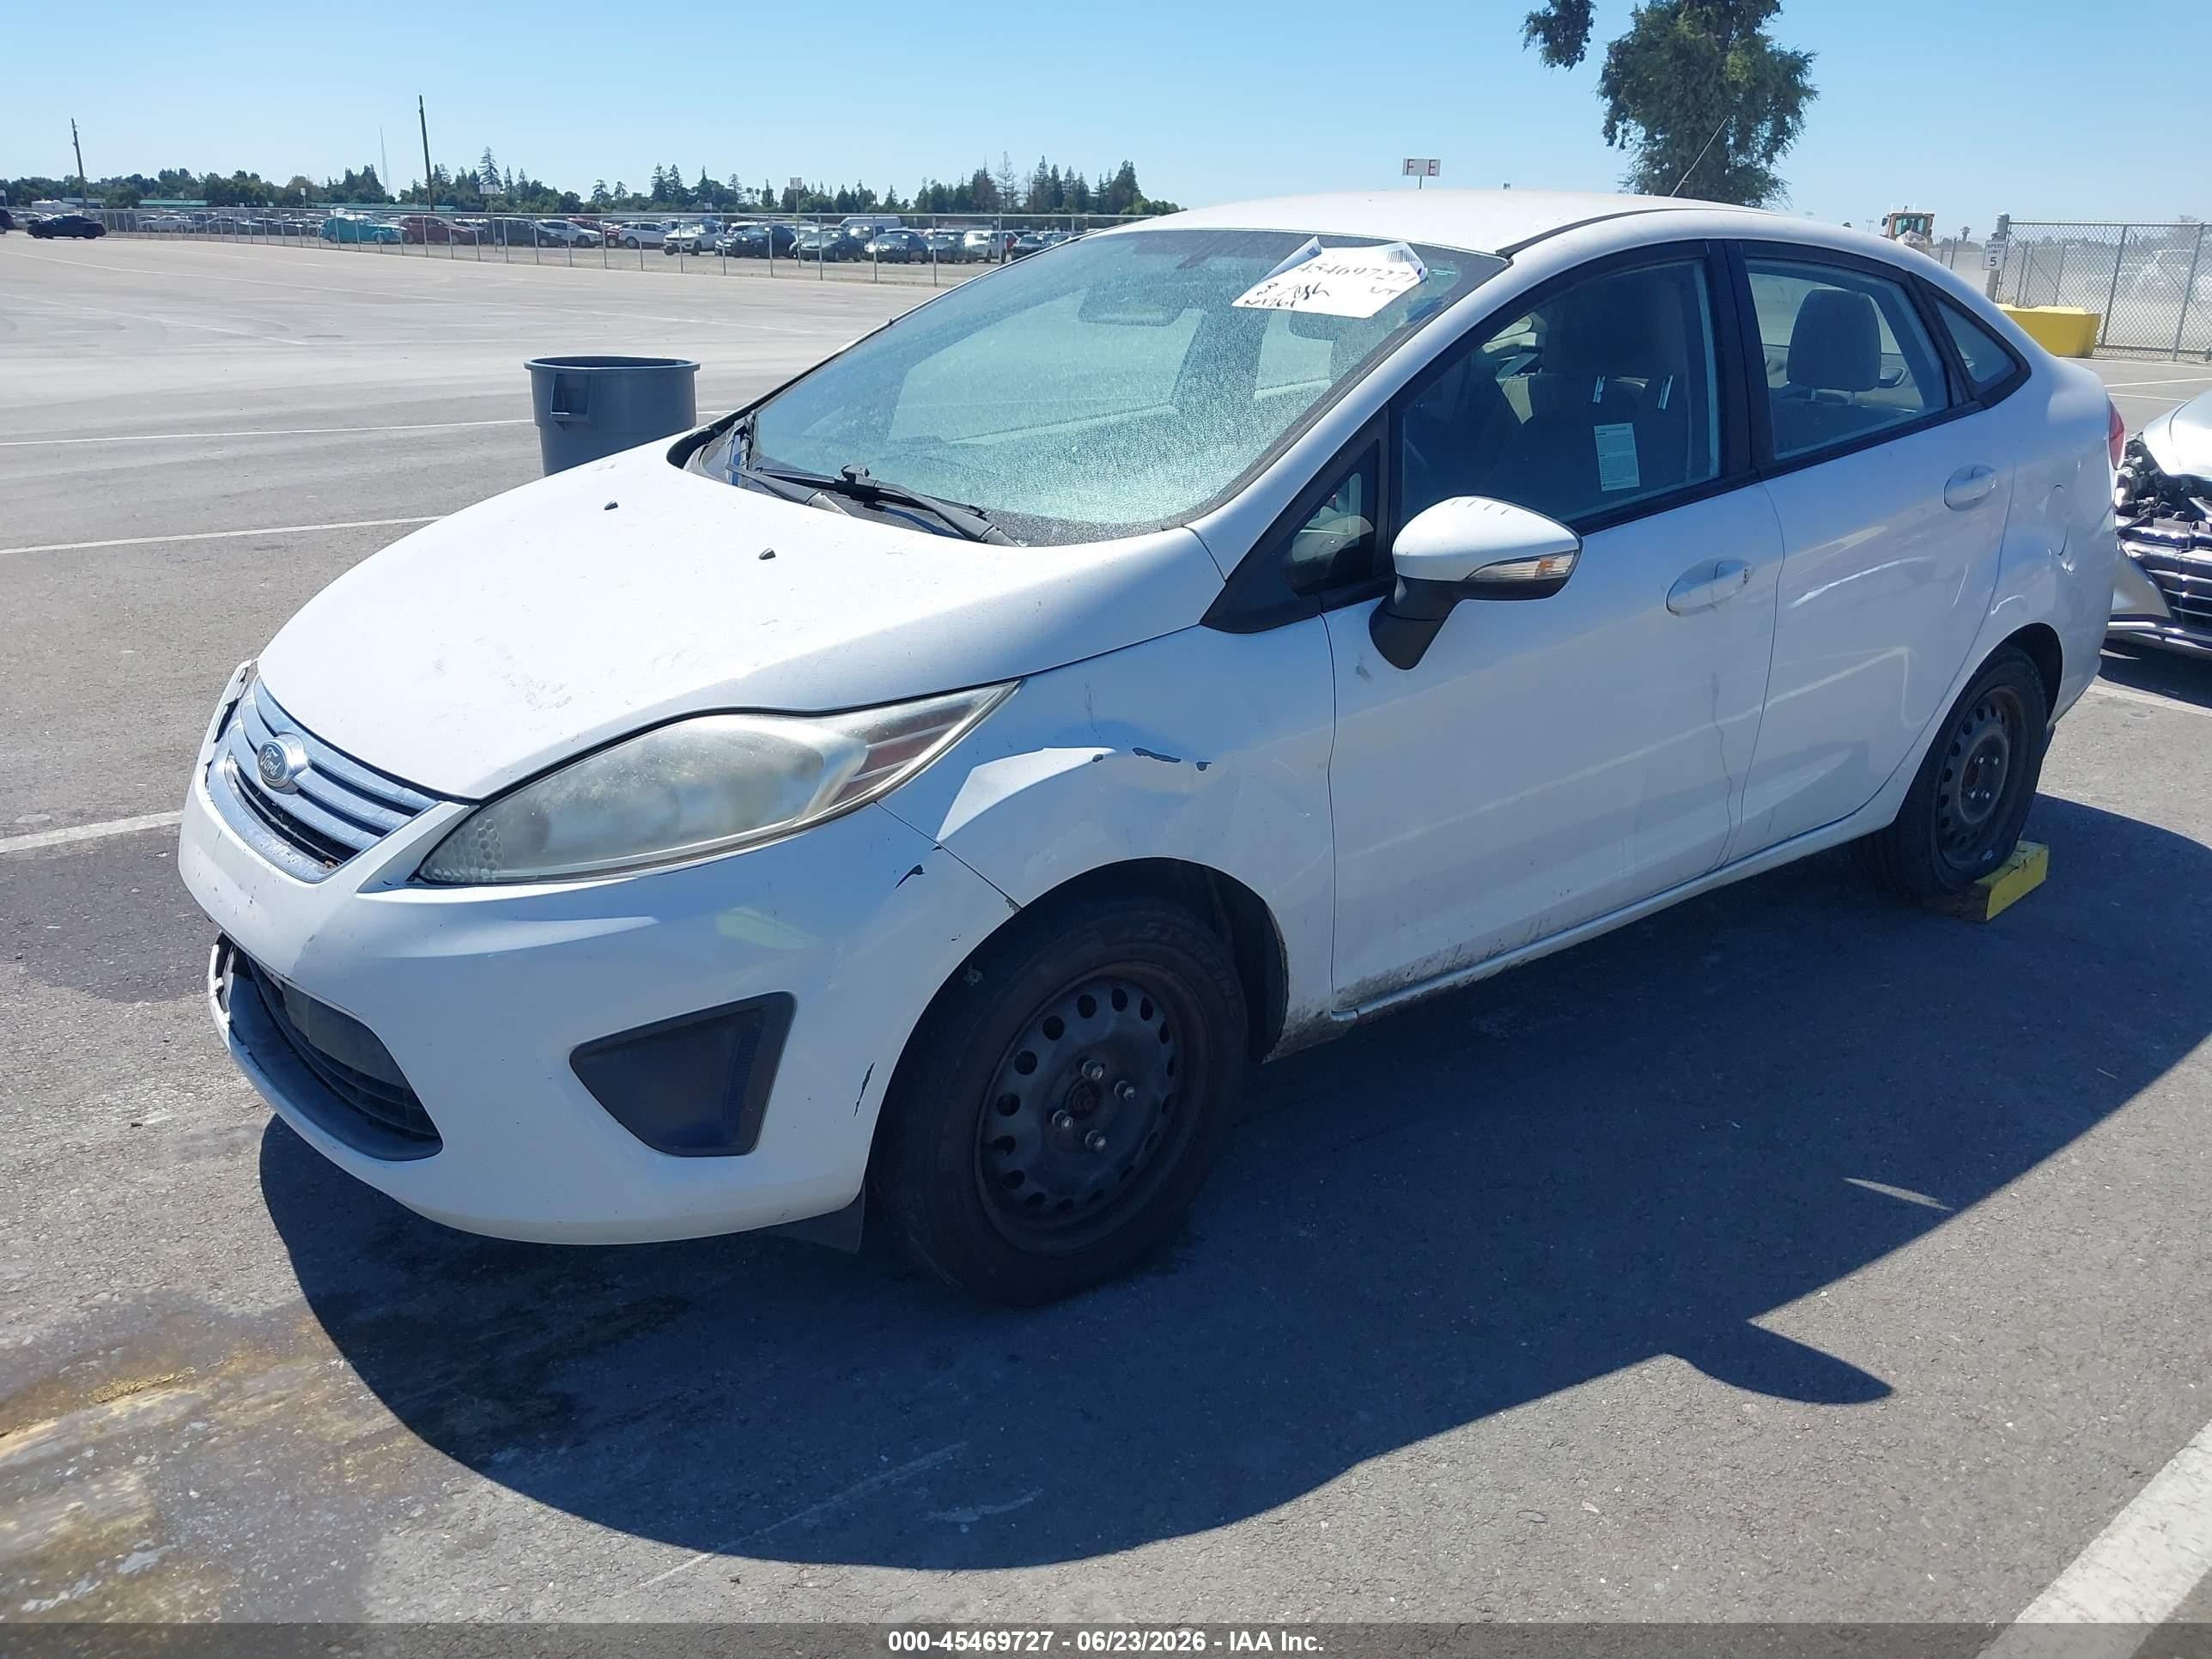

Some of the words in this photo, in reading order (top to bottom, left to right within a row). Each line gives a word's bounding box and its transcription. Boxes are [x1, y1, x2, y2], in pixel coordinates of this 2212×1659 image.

[1407, 159, 1415, 175] F
[1428, 159, 1437, 176] E
[1990, 256, 1997, 267] 5
[260, 746, 282, 776] Ford
